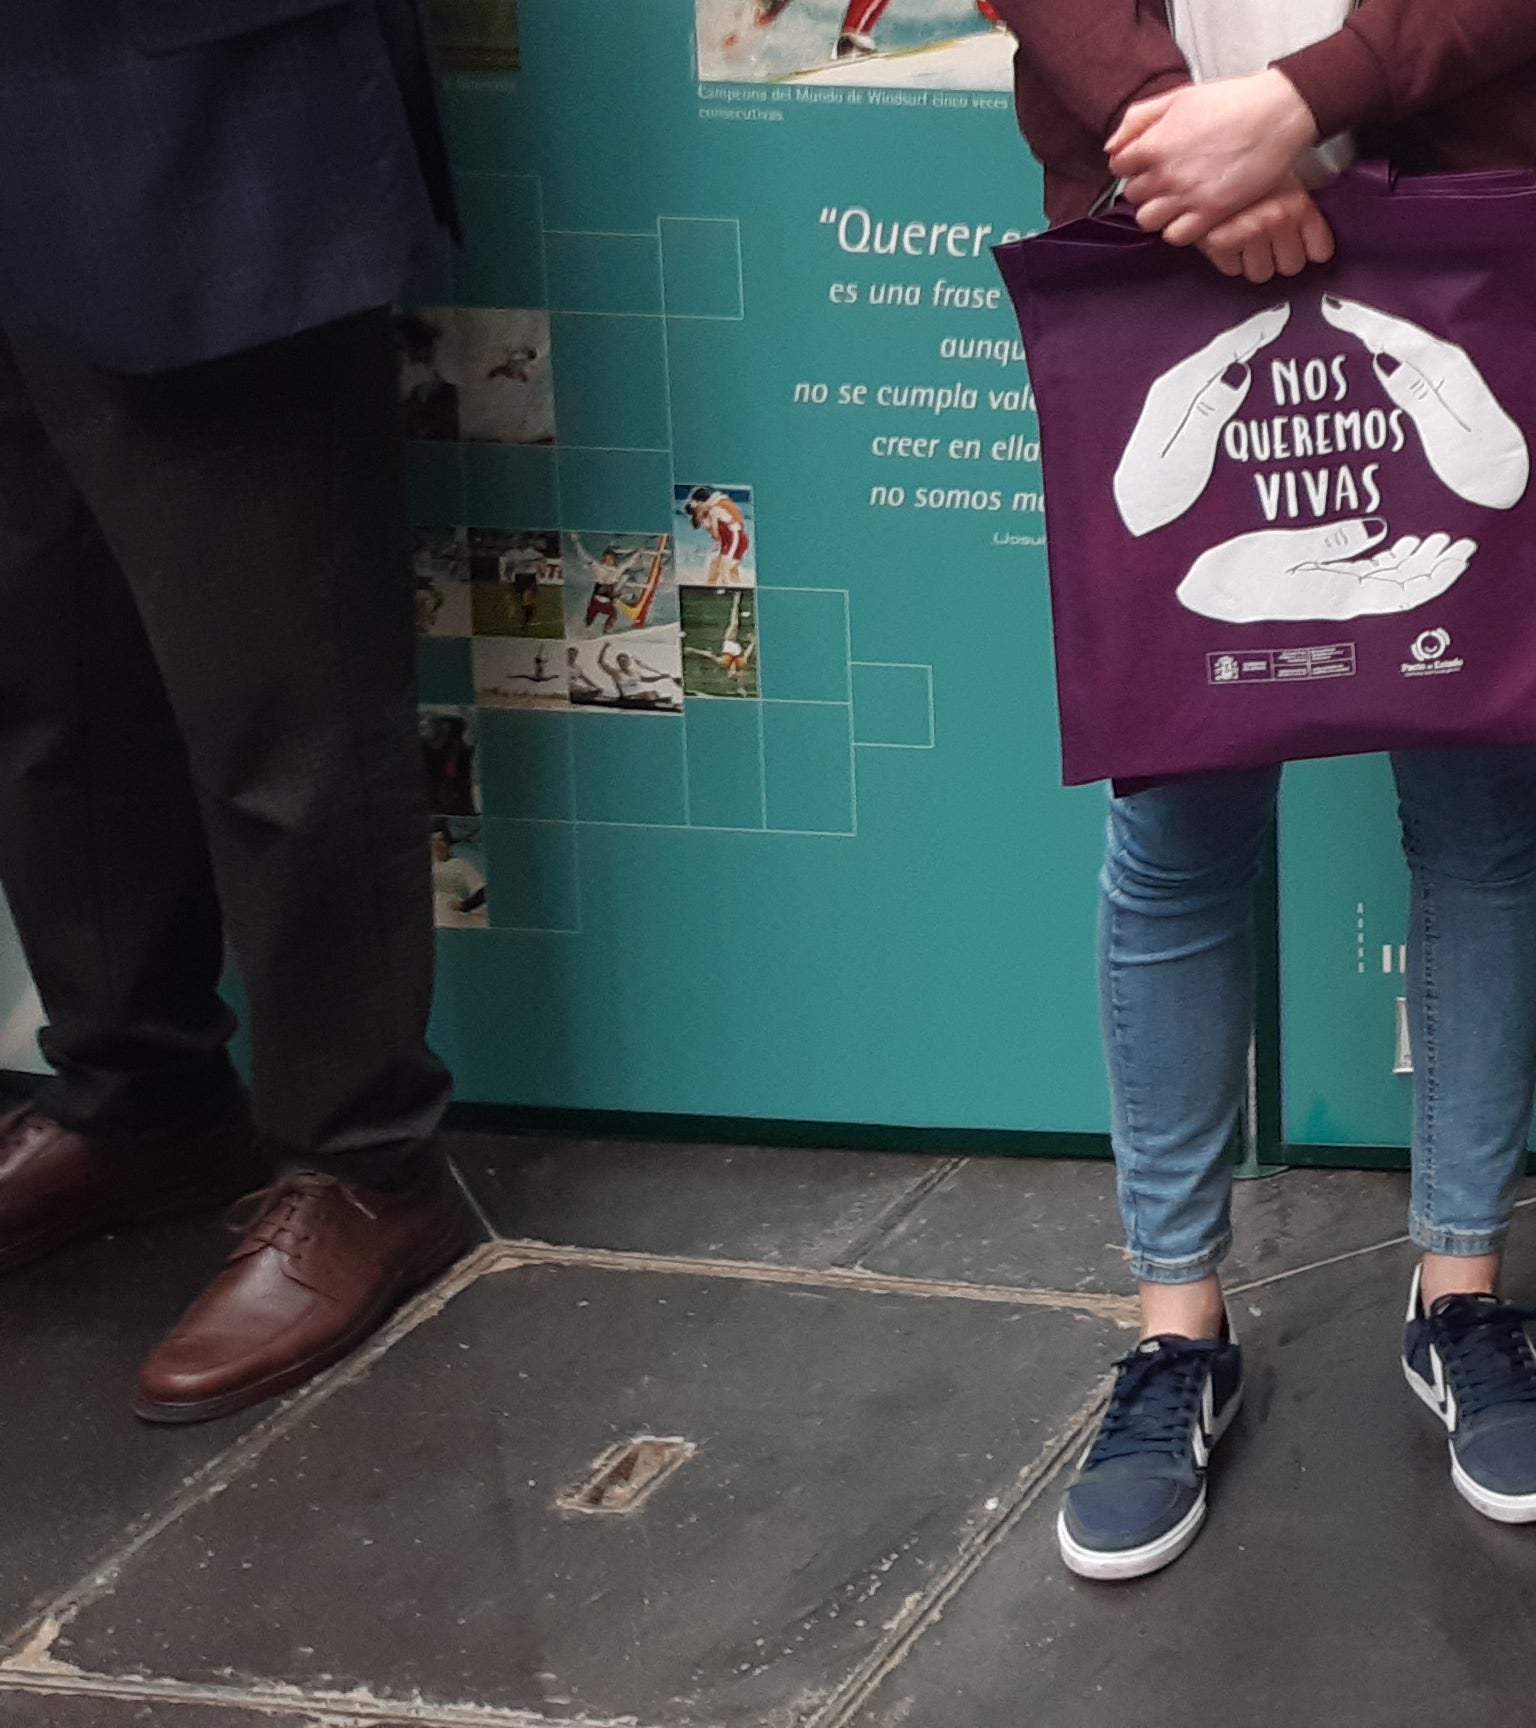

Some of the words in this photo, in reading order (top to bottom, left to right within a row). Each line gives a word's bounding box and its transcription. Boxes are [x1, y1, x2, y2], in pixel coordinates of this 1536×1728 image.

[697, 84, 767, 102] Campeona
[771, 86, 792, 102] del
[796, 88, 843, 104] Mundo
[847, 89, 862, 104] de
[971, 96, 1008, 110] veces
[818, 205, 992, 259] "Querer
[828, 280, 859, 306] es
[869, 282, 922, 308] una
[931, 279, 1001, 311] frase
[793, 380, 829, 405] no
[837, 382, 869, 407] se
[876, 382, 979, 415] cumpla
[1271, 354, 1349, 407] NOS
[871, 433, 941, 461] creer
[948, 435, 982, 462] en
[1222, 408, 1406, 464] QUEREMOS
[869, 485, 905, 508] no
[913, 485, 1002, 512] somos
[1254, 462, 1383, 521] VIVAS
